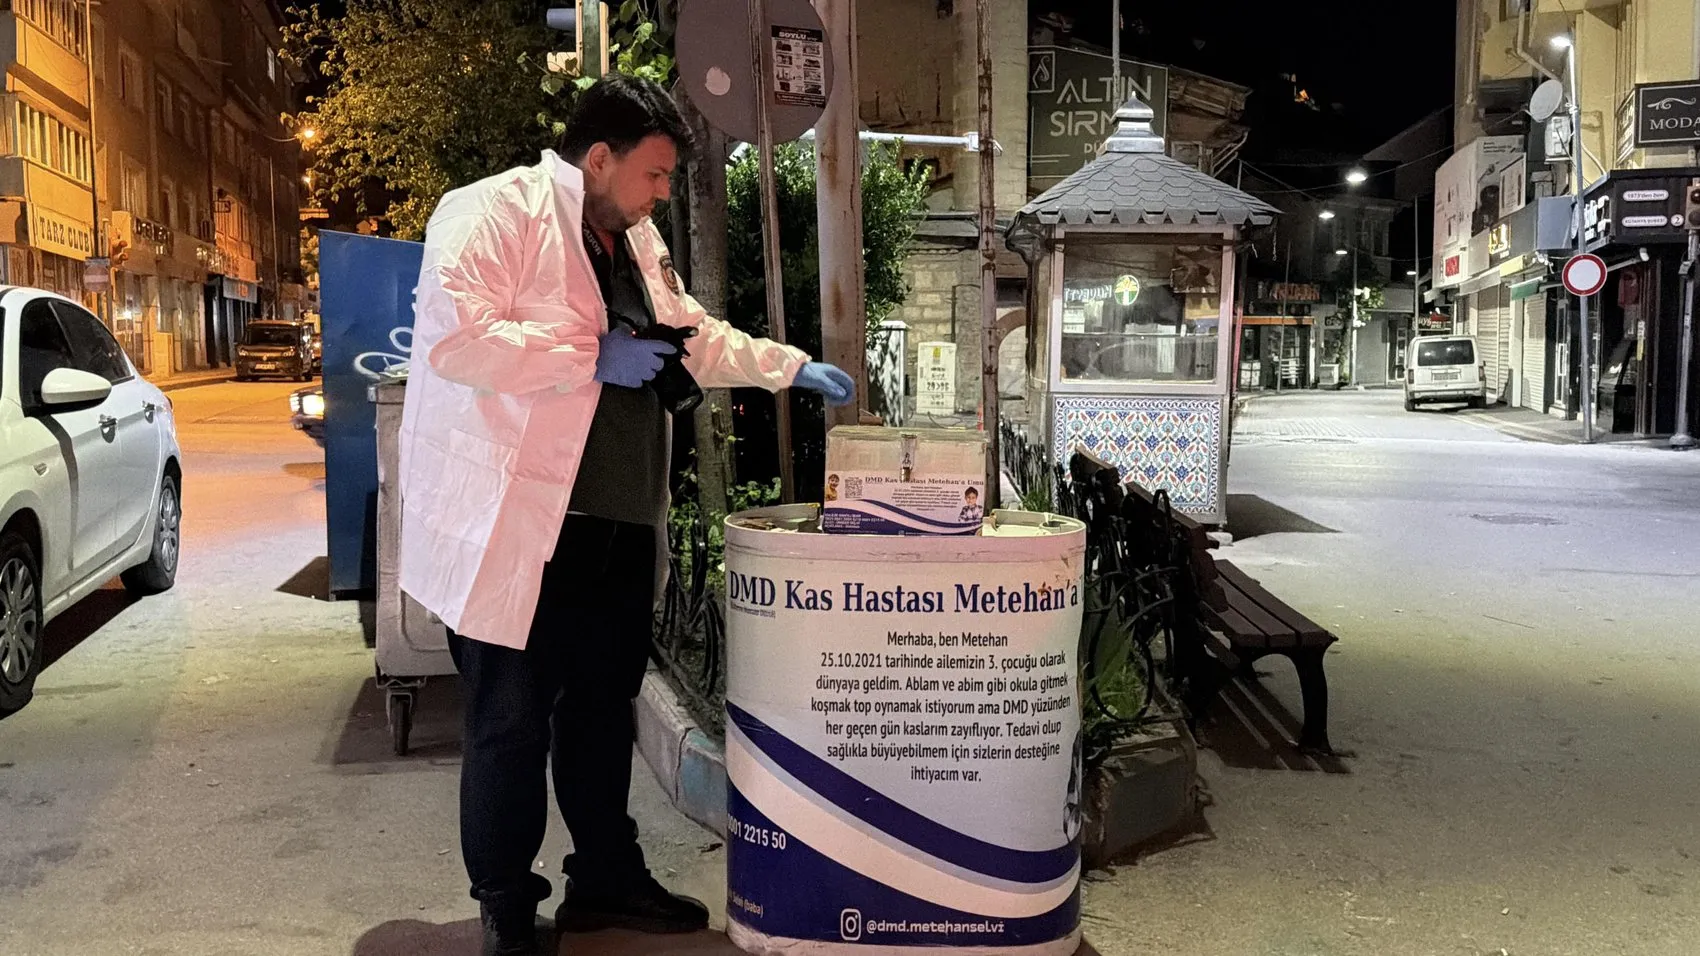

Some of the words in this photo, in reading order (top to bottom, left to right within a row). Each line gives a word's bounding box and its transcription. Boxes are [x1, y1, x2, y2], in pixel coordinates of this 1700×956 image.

[779, 31, 807, 40] SOYLU
[1056, 75, 1152, 104] ALTIN
[1674, 216, 1681, 225] 2
[40, 216, 65, 245] TARZ
[68, 226, 90, 252] CLUB
[730, 570, 776, 607] DMD
[785, 579, 833, 612] Kas
[842, 582, 945, 613] Hastası
[954, 578, 1078, 614] Metehan'a
[887, 631, 937, 649] Merhaba,
[938, 631, 959, 647] ben
[961, 631, 1008, 647] Metehan
[821, 652, 882, 668] 25.10.2021
[885, 653, 934, 669] tarihinde
[936, 653, 985, 670] ailemizin
[988, 654, 998, 670] 3.
[1001, 655, 1037, 673] çocuğu
[1039, 650, 1066, 668] olarak
[816, 675, 860, 694] dünyaya
[863, 675, 902, 694] geldim.
[905, 676, 939, 691] Ablam
[943, 680, 955, 691] ve
[957, 676, 984, 692] abim
[986, 676, 1007, 696] gibi
[1009, 674, 1038, 692] okula
[1040, 671, 1069, 694] gitmek
[811, 697, 851, 716] koşmak
[854, 699, 872, 716] top
[874, 698, 922, 716] oynamak
[925, 699, 975, 717] istiyorum
[977, 703, 1000, 715] ama
[1003, 699, 1029, 715] DMD
[1031, 695, 1071, 717] yüzünden
[825, 720, 843, 735] her
[846, 723, 877, 739] geçen
[880, 720, 900, 739] gün
[903, 720, 948, 736] kaslarım
[951, 722, 1003, 740] zayıflıyor.
[1006, 721, 1040, 737] Tedavi
[1042, 719, 1062, 736] olup
[827, 743, 868, 761] sağlıkla
[871, 743, 948, 761] büyüyebilmem
[951, 744, 970, 762] için
[972, 745, 1012, 760] sizlerin
[1014, 742, 1060, 761] desteğine
[911, 766, 959, 784] ihtiyacım
[962, 769, 982, 782] var.
[744, 823, 769, 847] 2215
[771, 831, 786, 850] 50
[866, 919, 1005, 935] @dmd.metehanselvi
